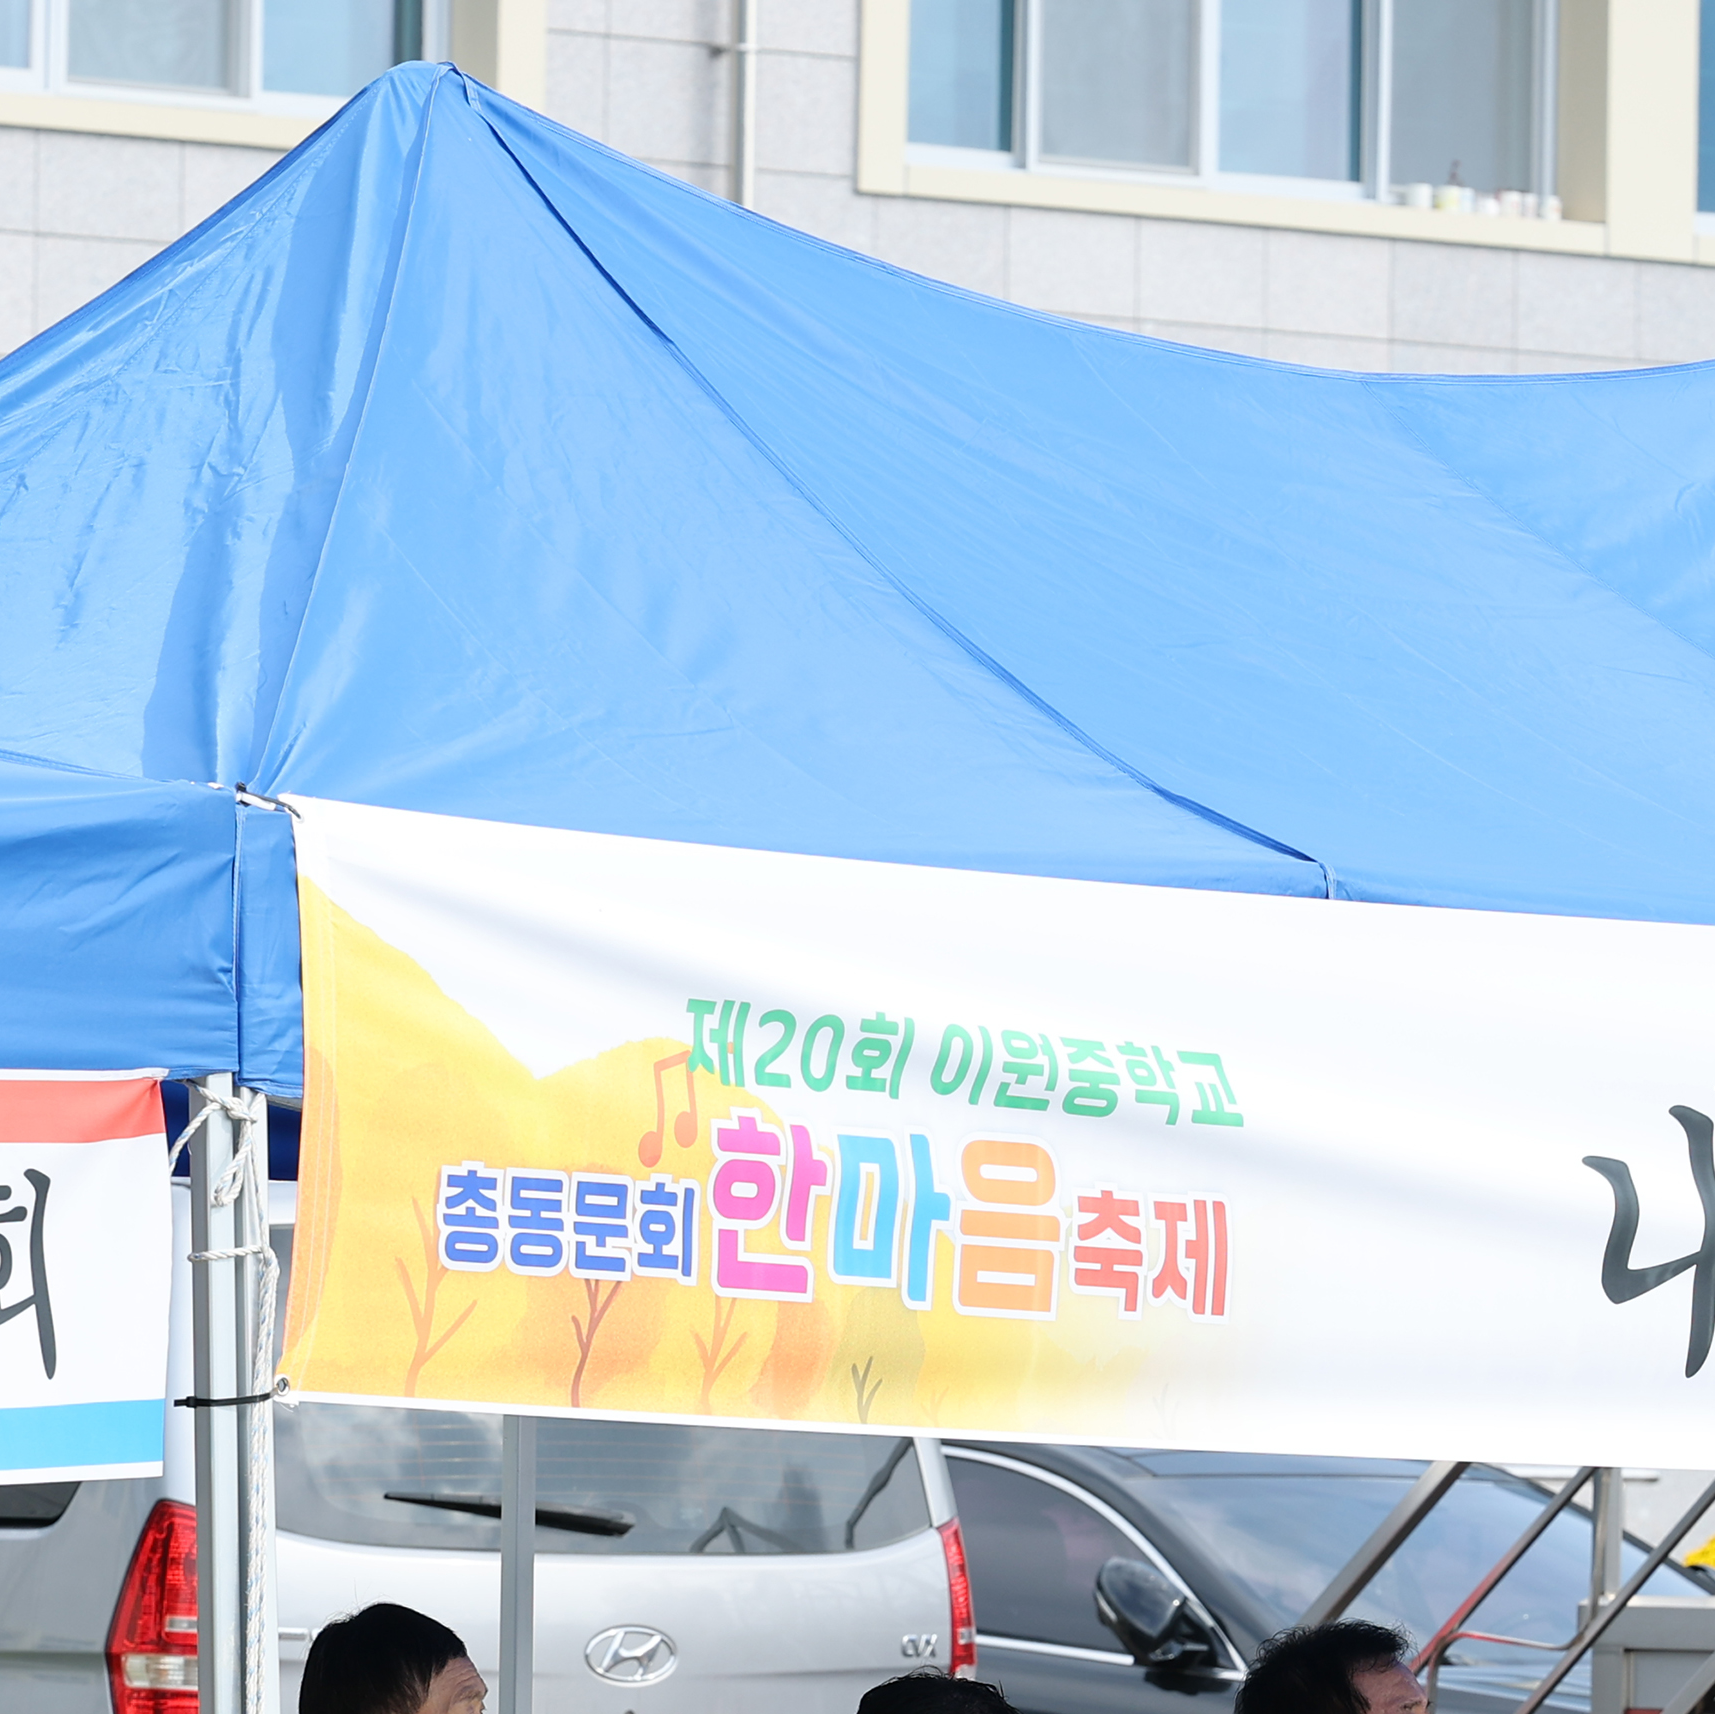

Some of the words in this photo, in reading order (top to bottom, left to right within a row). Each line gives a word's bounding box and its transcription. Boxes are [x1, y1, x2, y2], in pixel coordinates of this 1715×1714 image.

[686, 997, 916, 1100] 제20회
[929, 1021, 1245, 1128] 이원중학교
[442, 1165, 697, 1279] 총동문회
[712, 1112, 1058, 1318] 한마음
[1071, 1187, 1228, 1319] 축제
[902, 1633, 937, 1658] CVX
